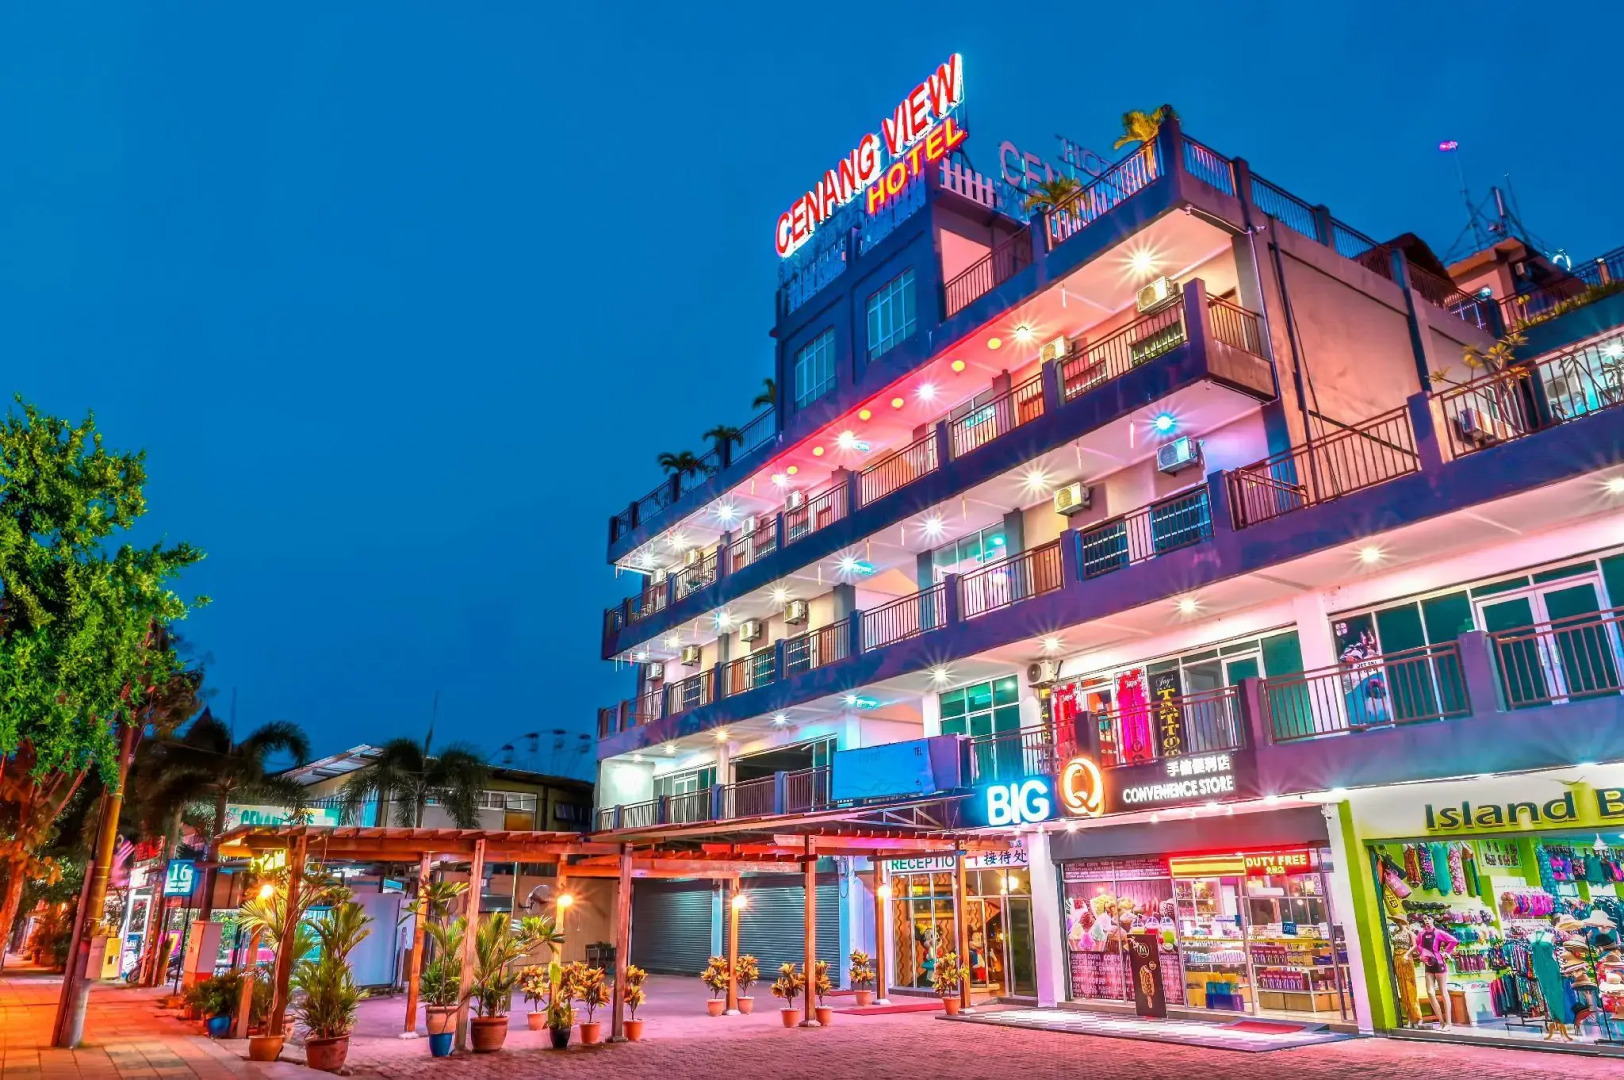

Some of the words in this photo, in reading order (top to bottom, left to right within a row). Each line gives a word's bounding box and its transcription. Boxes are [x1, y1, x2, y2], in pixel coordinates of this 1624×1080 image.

[776, 133, 880, 257] CENANG
[882, 53, 962, 158] VIEW
[865, 117, 965, 217] HOTEL
[986, 779, 1050, 827] BIG
[1061, 757, 1105, 818] Q
[1123, 781, 1199, 804] CONVENIENCE
[1200, 775, 1234, 796] STORE
[1424, 790, 1579, 832] Island
[169, 863, 191, 881] 16
[891, 854, 956, 870] RECEPTIO
[983, 849, 1028, 866] 接待处
[1246, 855, 1275, 868] DUTY
[1277, 854, 1307, 866] FREE
